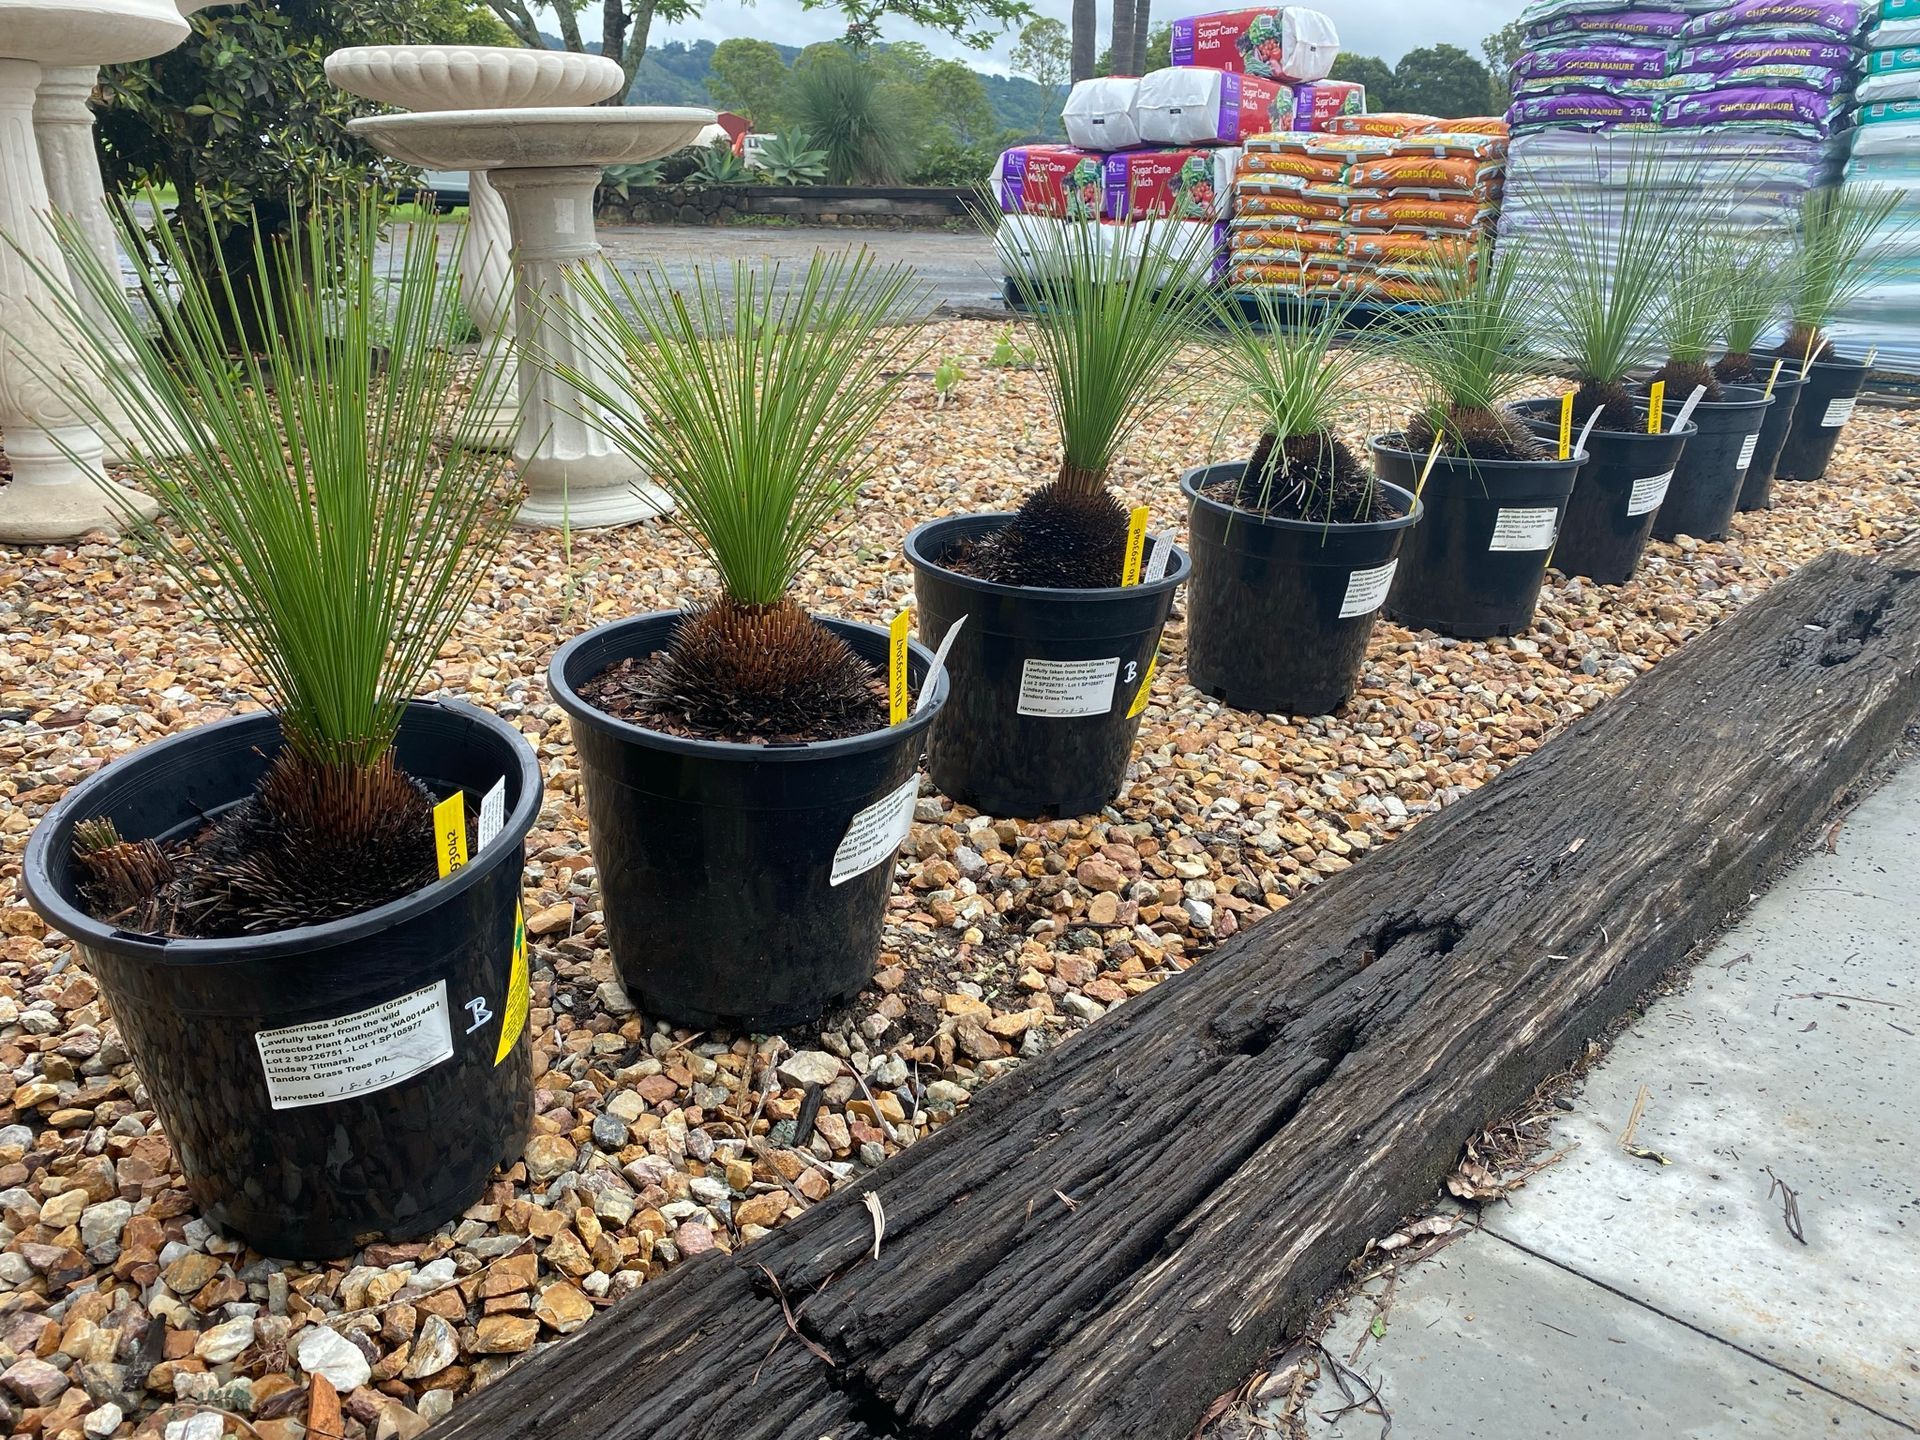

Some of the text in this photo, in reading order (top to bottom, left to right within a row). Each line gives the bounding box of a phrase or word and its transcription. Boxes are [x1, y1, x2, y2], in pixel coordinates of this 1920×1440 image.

[1826, 14, 1846, 29] 25L
[1198, 27, 1220, 38] Sugar
[1220, 25, 1239, 35] Cane
[1614, 23, 1649, 33] MANURE
[1656, 26, 1674, 35] 25L
[1198, 39, 1220, 50] Mulch
[1773, 49, 1812, 57] MANURE
[1820, 48, 1840, 58] 25L
[1564, 61, 1660, 72] CHICKEN MANURE 25L
[1242, 87, 1271, 100] Sugar Cane
[1242, 99, 1258, 111] Mulch
[1315, 97, 1340, 108] Sugar Cane
[1719, 104, 1757, 113] CHICKEN
[1757, 103, 1795, 112] MANURE
[1314, 109, 1328, 119] Mulch
[1556, 108, 1648, 117] CHICKEN MANURE 25L
[1364, 123, 1393, 133] GARDEN
[1029, 160, 1048, 173] Sugar
[1049, 161, 1066, 173] Cane
[1131, 165, 1152, 177] Sugar
[1152, 164, 1172, 174] Cane
[1321, 168, 1335, 177] 25L
[1395, 169, 1431, 180] GARDEN
[1431, 170, 1448, 180] SOIL
[1324, 208, 1338, 217] 25L
[1428, 210, 1447, 220] SOIL
[1322, 273, 1335, 281] 25L
[1130, 528, 1141, 567] 1293048
[896, 638, 904, 681] 1293047
[1123, 660, 1138, 684] B
[894, 682, 903, 698] No
[259, 984, 437, 1039] Xanthorrhoea Johnsonii (Grass Tree)
[464, 996, 493, 1035] B
[261, 1010, 400, 1049] Lawfully taken from the wild
[263, 1001, 440, 1057] Protected Plant Authority WA0014491
[266, 1057, 284, 1065] Lot
[285, 1056, 291, 1064] 2
[294, 1049, 343, 1062] SP226751
[352, 1042, 368, 1052] Lot
[379, 1020, 422, 1044] SP105977
[268, 1056, 355, 1074] Lindsay Titmarsh
[270, 1055, 391, 1083] Tandora Grass Trees P/L
[274, 1091, 325, 1102] Harvested
